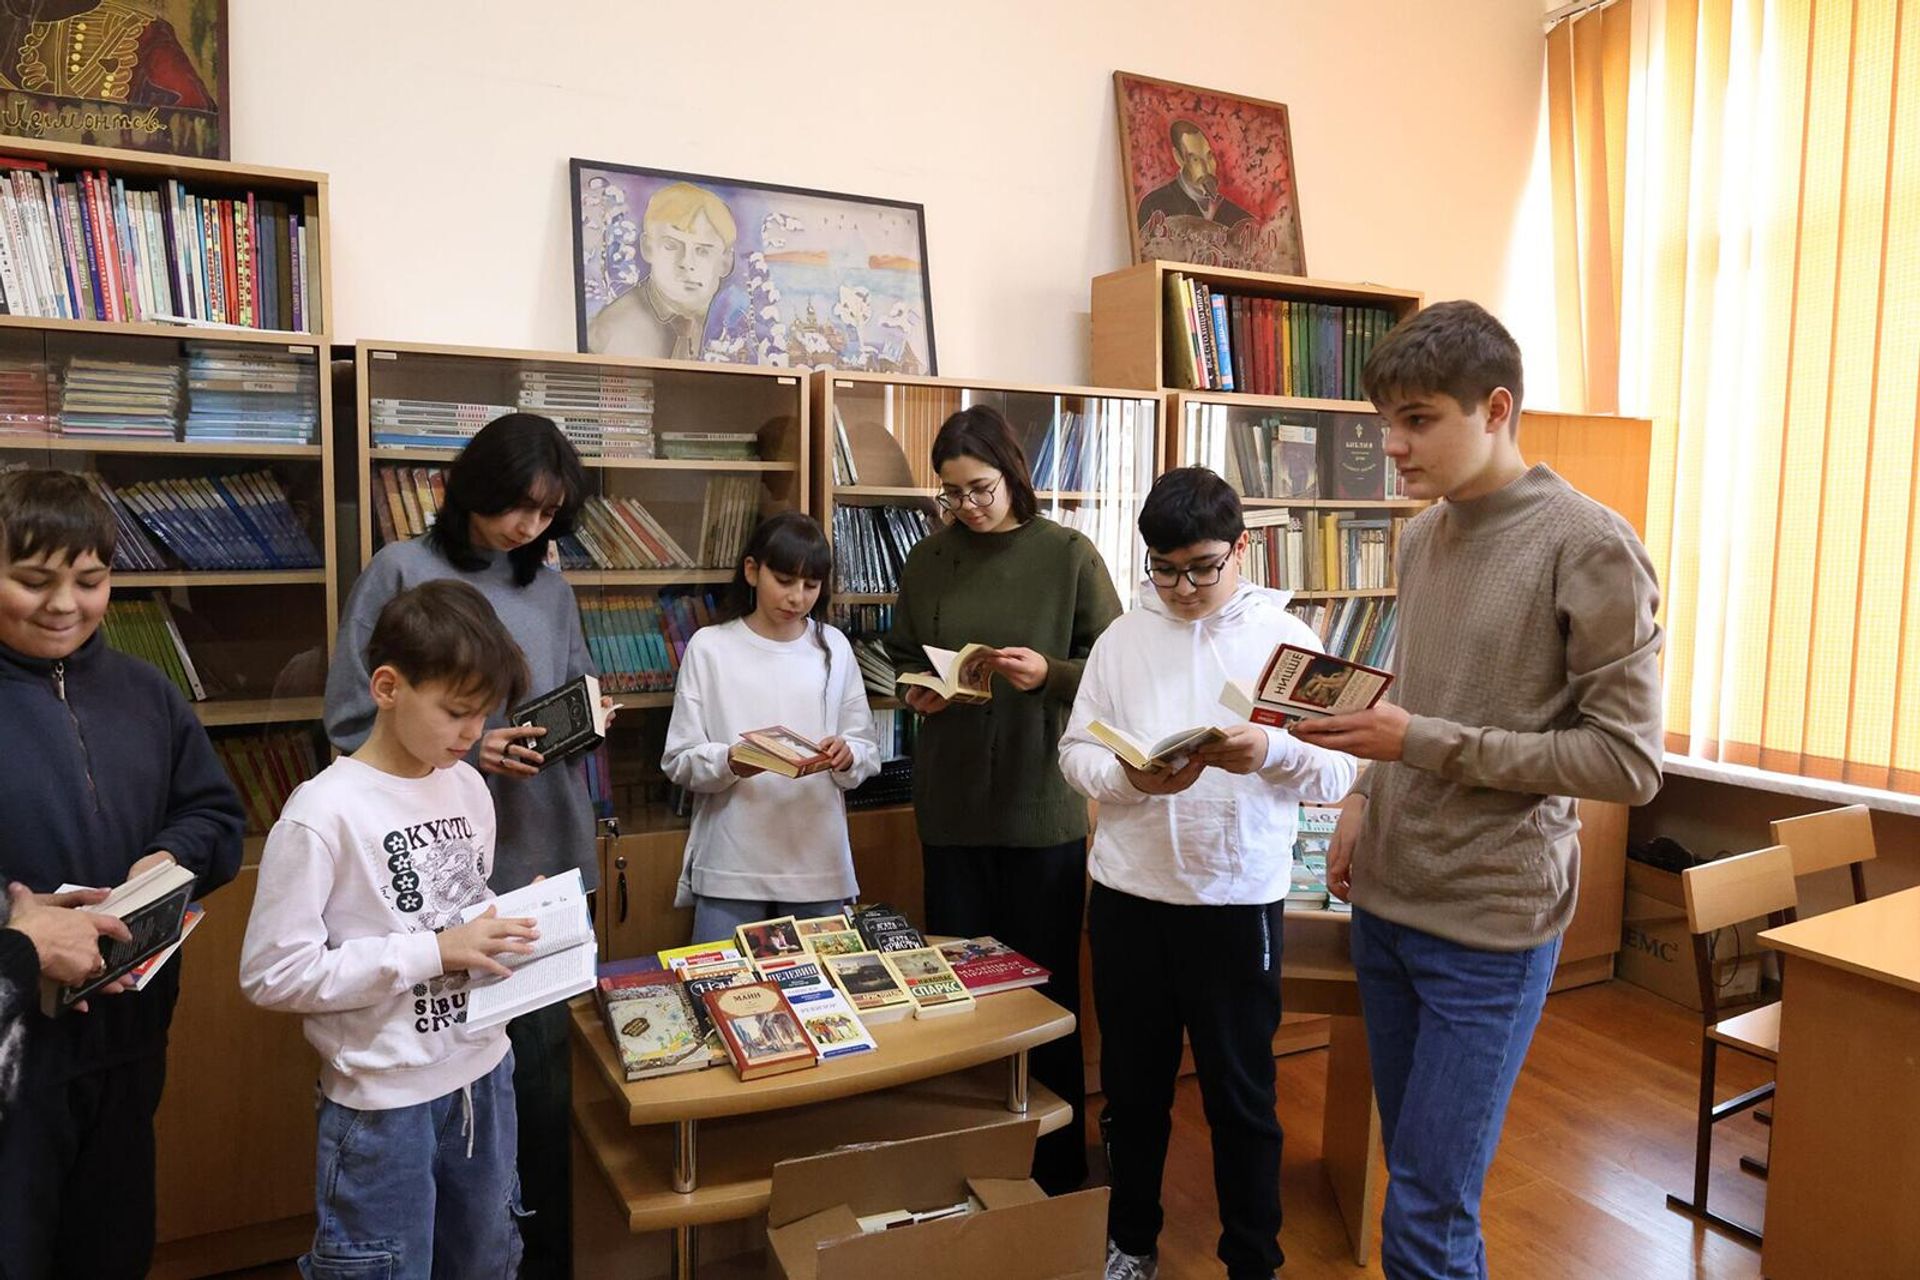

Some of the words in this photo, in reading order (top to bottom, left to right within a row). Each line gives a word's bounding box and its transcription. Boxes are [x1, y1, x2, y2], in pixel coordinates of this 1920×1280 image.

[1274, 653, 1304, 695] НИЦШЕ
[733, 992, 761, 1001] МАНН
[911, 981, 962, 997] СПАРКС
